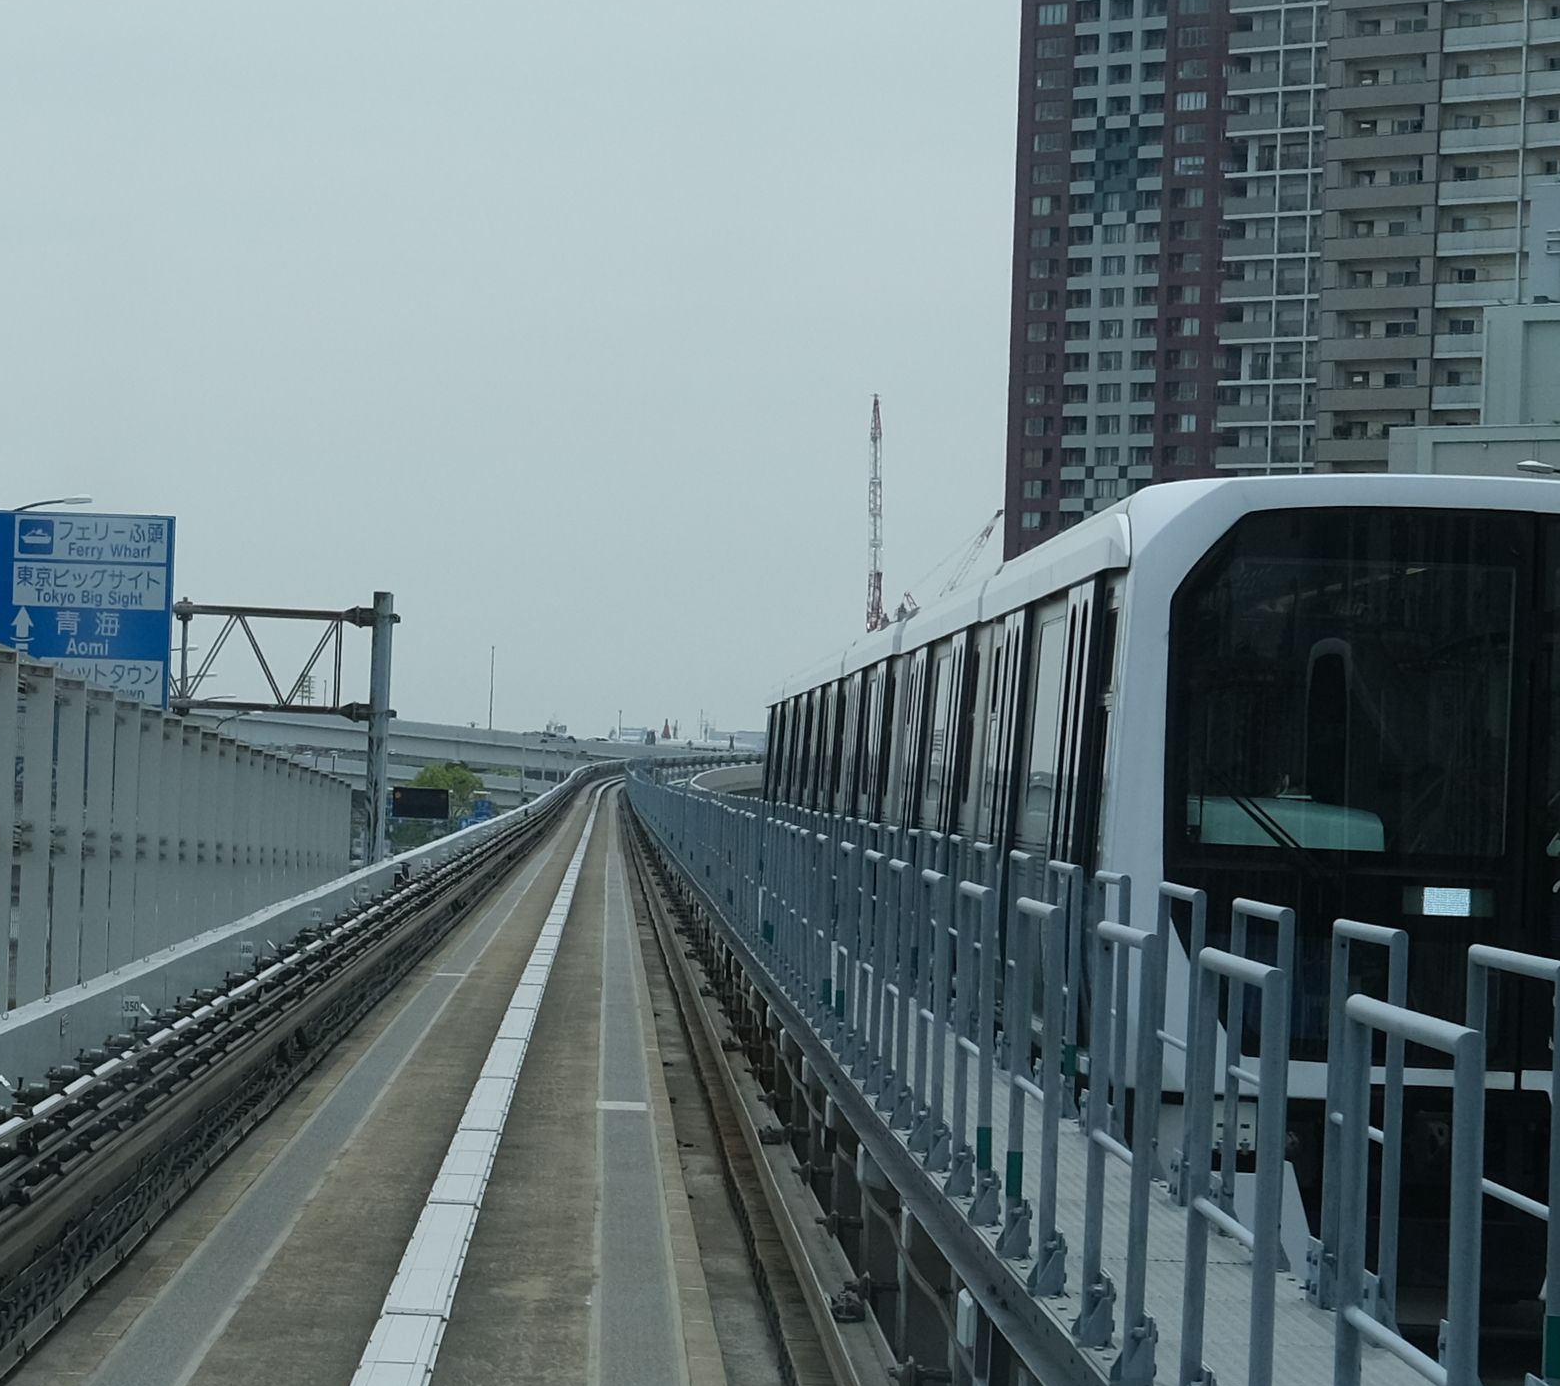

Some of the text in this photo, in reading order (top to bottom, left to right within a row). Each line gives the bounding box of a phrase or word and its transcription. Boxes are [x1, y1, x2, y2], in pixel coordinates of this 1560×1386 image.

[58, 521, 164, 544] フェリーふ頭
[68, 543, 151, 559] Ferry Wharf
[16, 566, 160, 590] 東京ビッグサイト
[35, 588, 143, 607] Tokyo Big Sight
[56, 611, 120, 637] 青海
[65, 638, 109, 655] Aomi
